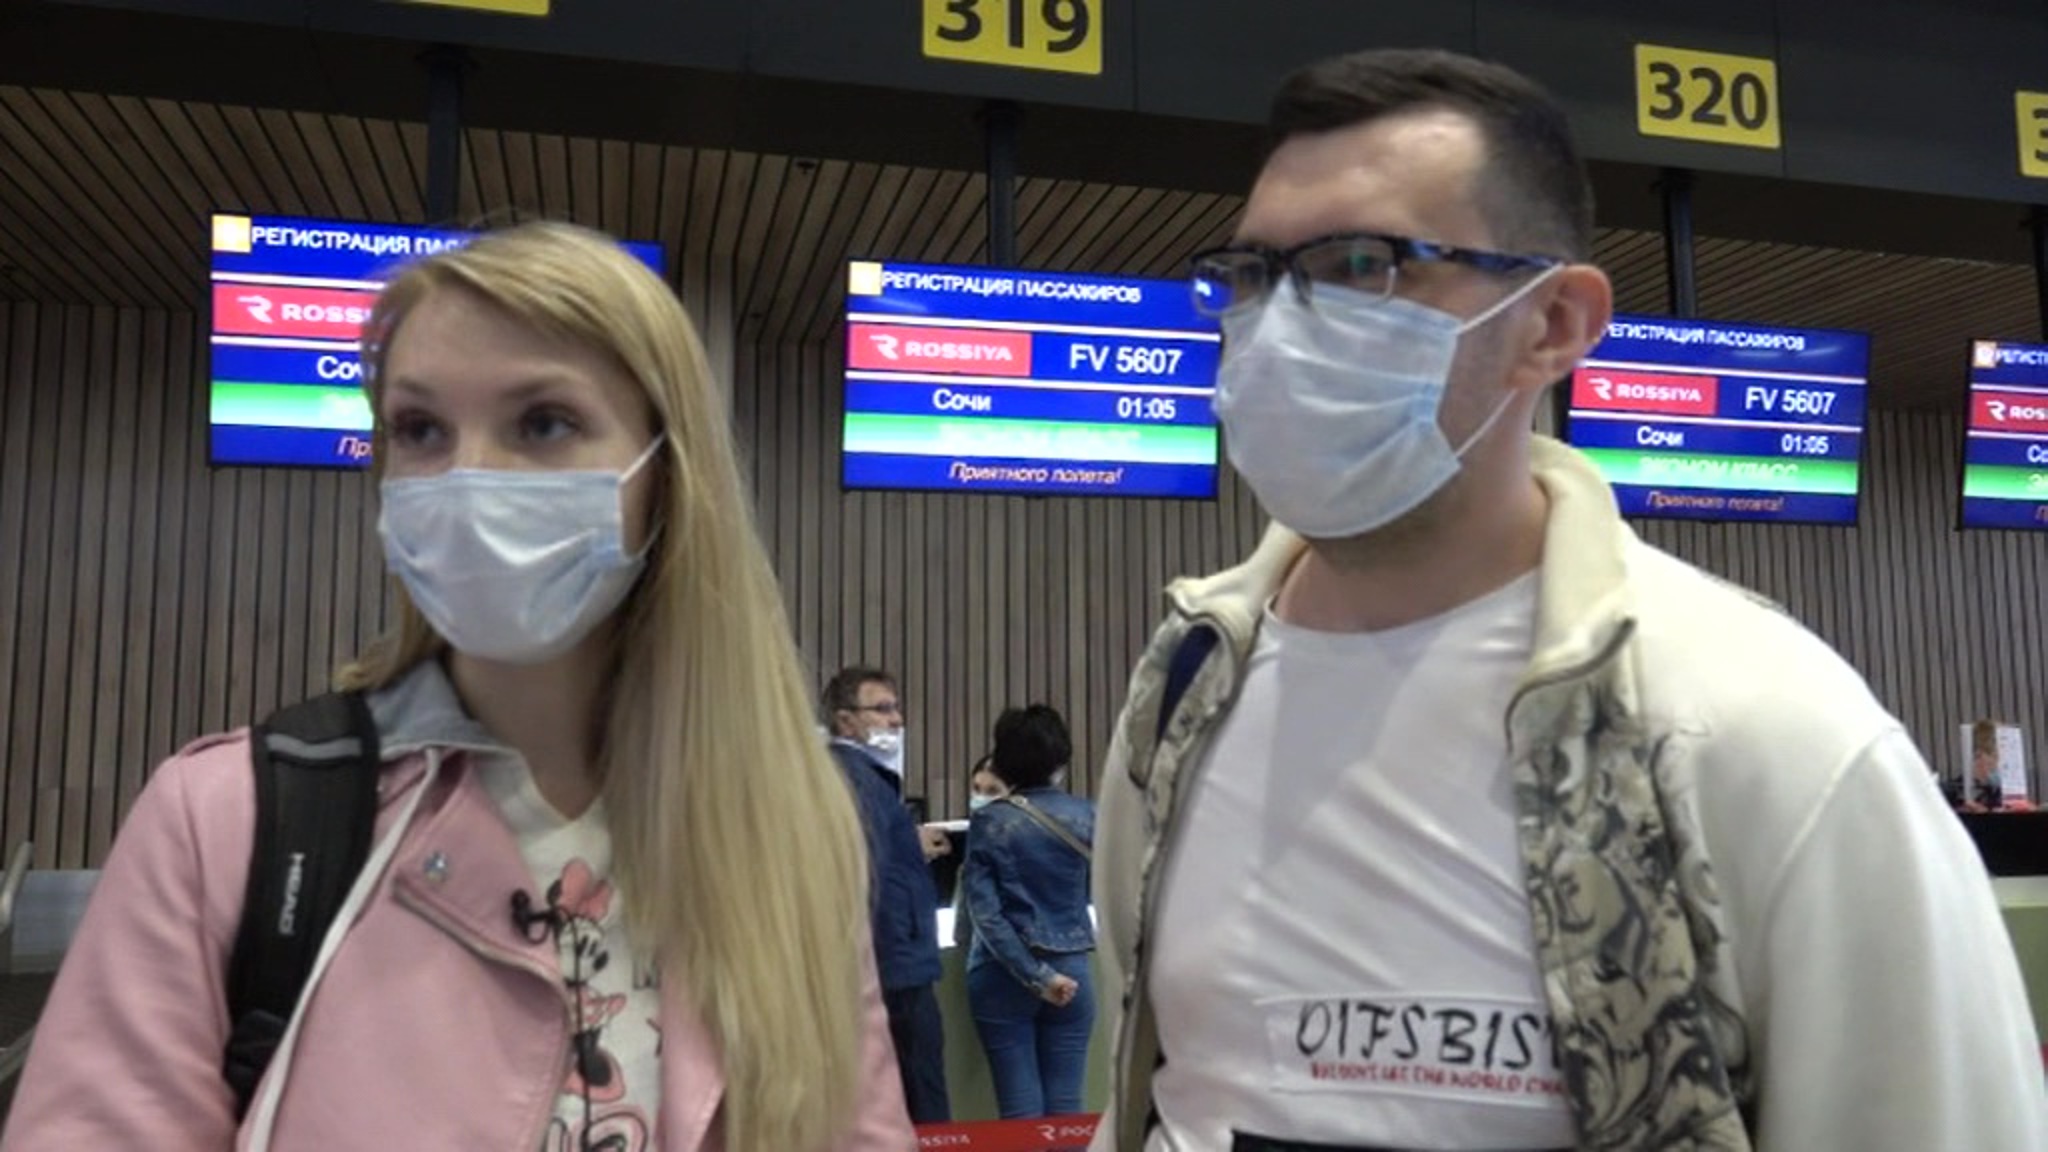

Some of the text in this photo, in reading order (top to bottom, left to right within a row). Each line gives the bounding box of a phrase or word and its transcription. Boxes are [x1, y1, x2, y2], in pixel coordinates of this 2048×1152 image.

[935, 0, 1090, 53] 319
[1648, 61, 1768, 130] 320
[251, 226, 462, 255] РЕГИСТРАЦИЯ ПАС
[881, 271, 1142, 303] РЕГИСТРАЦИЯ ПАССАЖИРОВ
[905, 340, 1012, 361] ROSSIYA
[1707, 329, 1805, 351] ПАССАЖИРОВ
[1069, 343, 1183, 375] FV 5607
[932, 389, 991, 412] Сочи
[1616, 383, 1702, 402] ROSSIYA
[1745, 386, 1836, 414] FV 5607
[1117, 397, 1176, 419] 01:05
[1636, 426, 1684, 446] Сочи
[1781, 434, 1829, 454] 01:05
[949, 462, 1048, 483] Приятного
